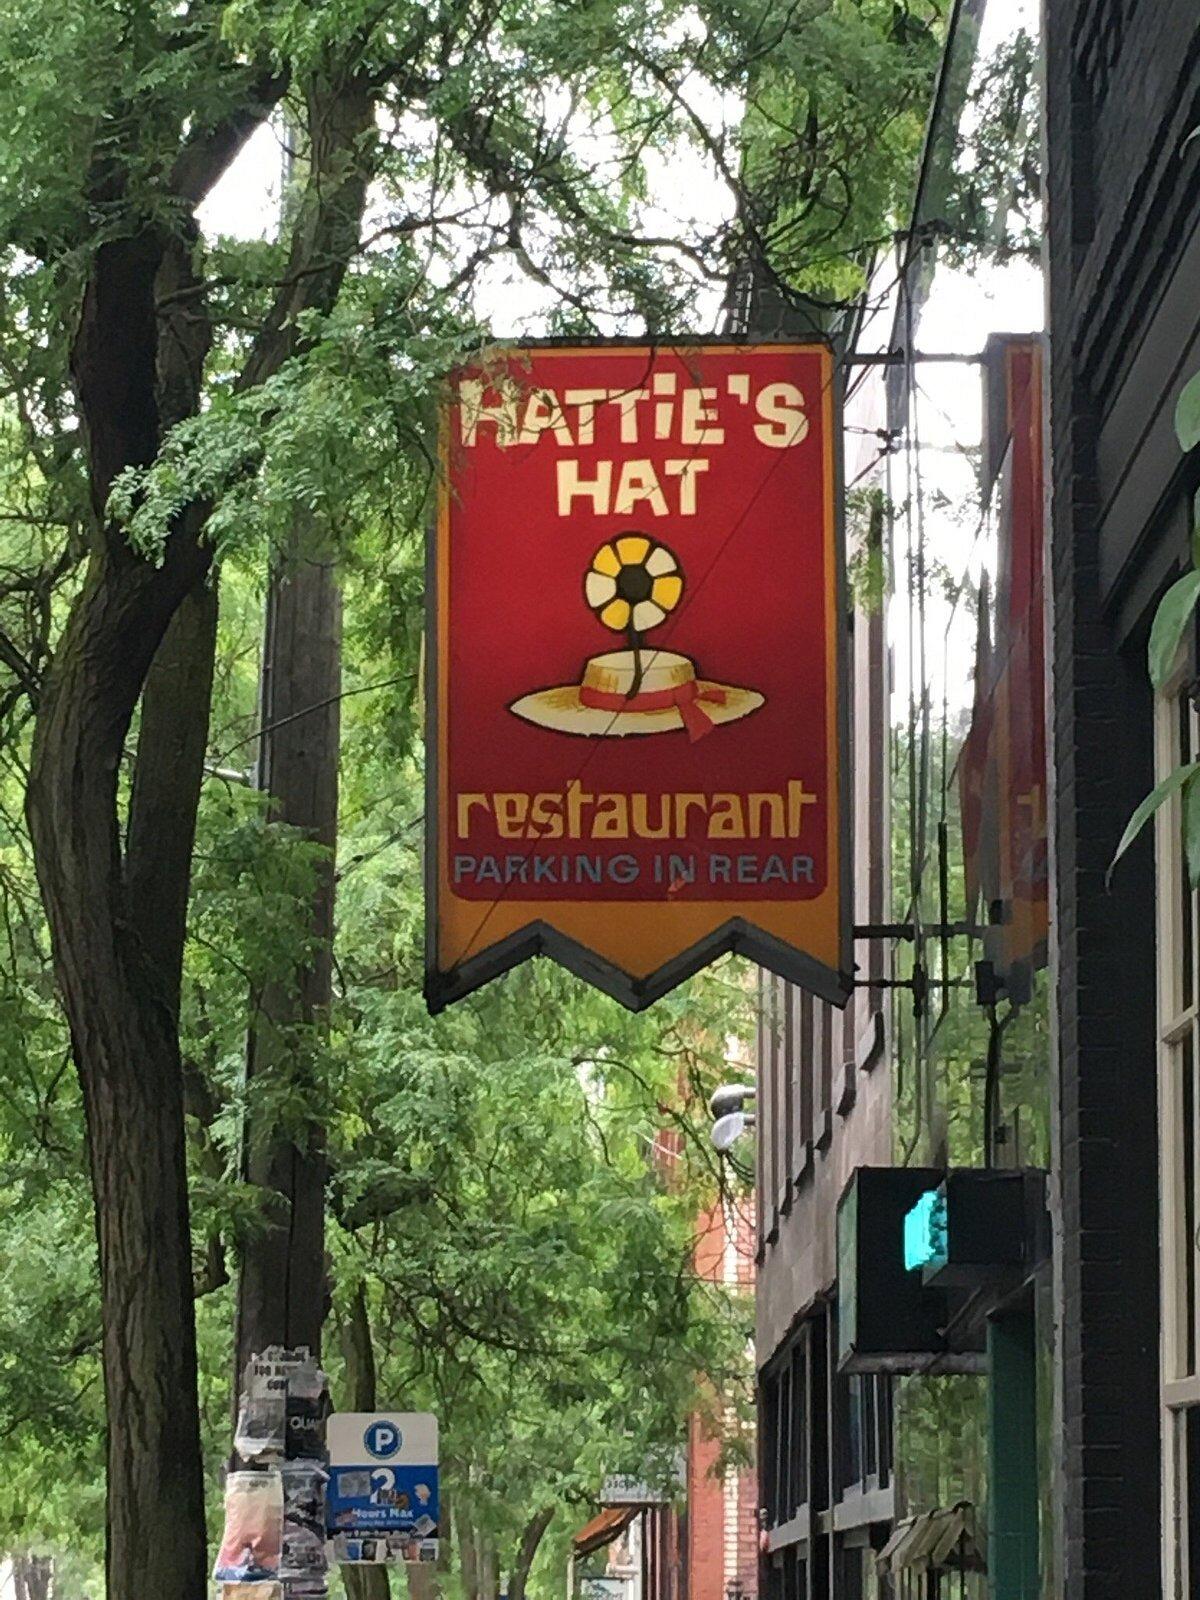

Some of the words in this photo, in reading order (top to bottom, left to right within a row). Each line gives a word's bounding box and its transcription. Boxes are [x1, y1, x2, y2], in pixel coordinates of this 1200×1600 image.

[556, 459, 709, 516] HAT
[457, 779, 817, 839] restaurant
[453, 855, 640, 884] PARKING
[654, 855, 696, 884] IN
[709, 855, 815, 884] REAR
[375, 1428, 394, 1451] P
